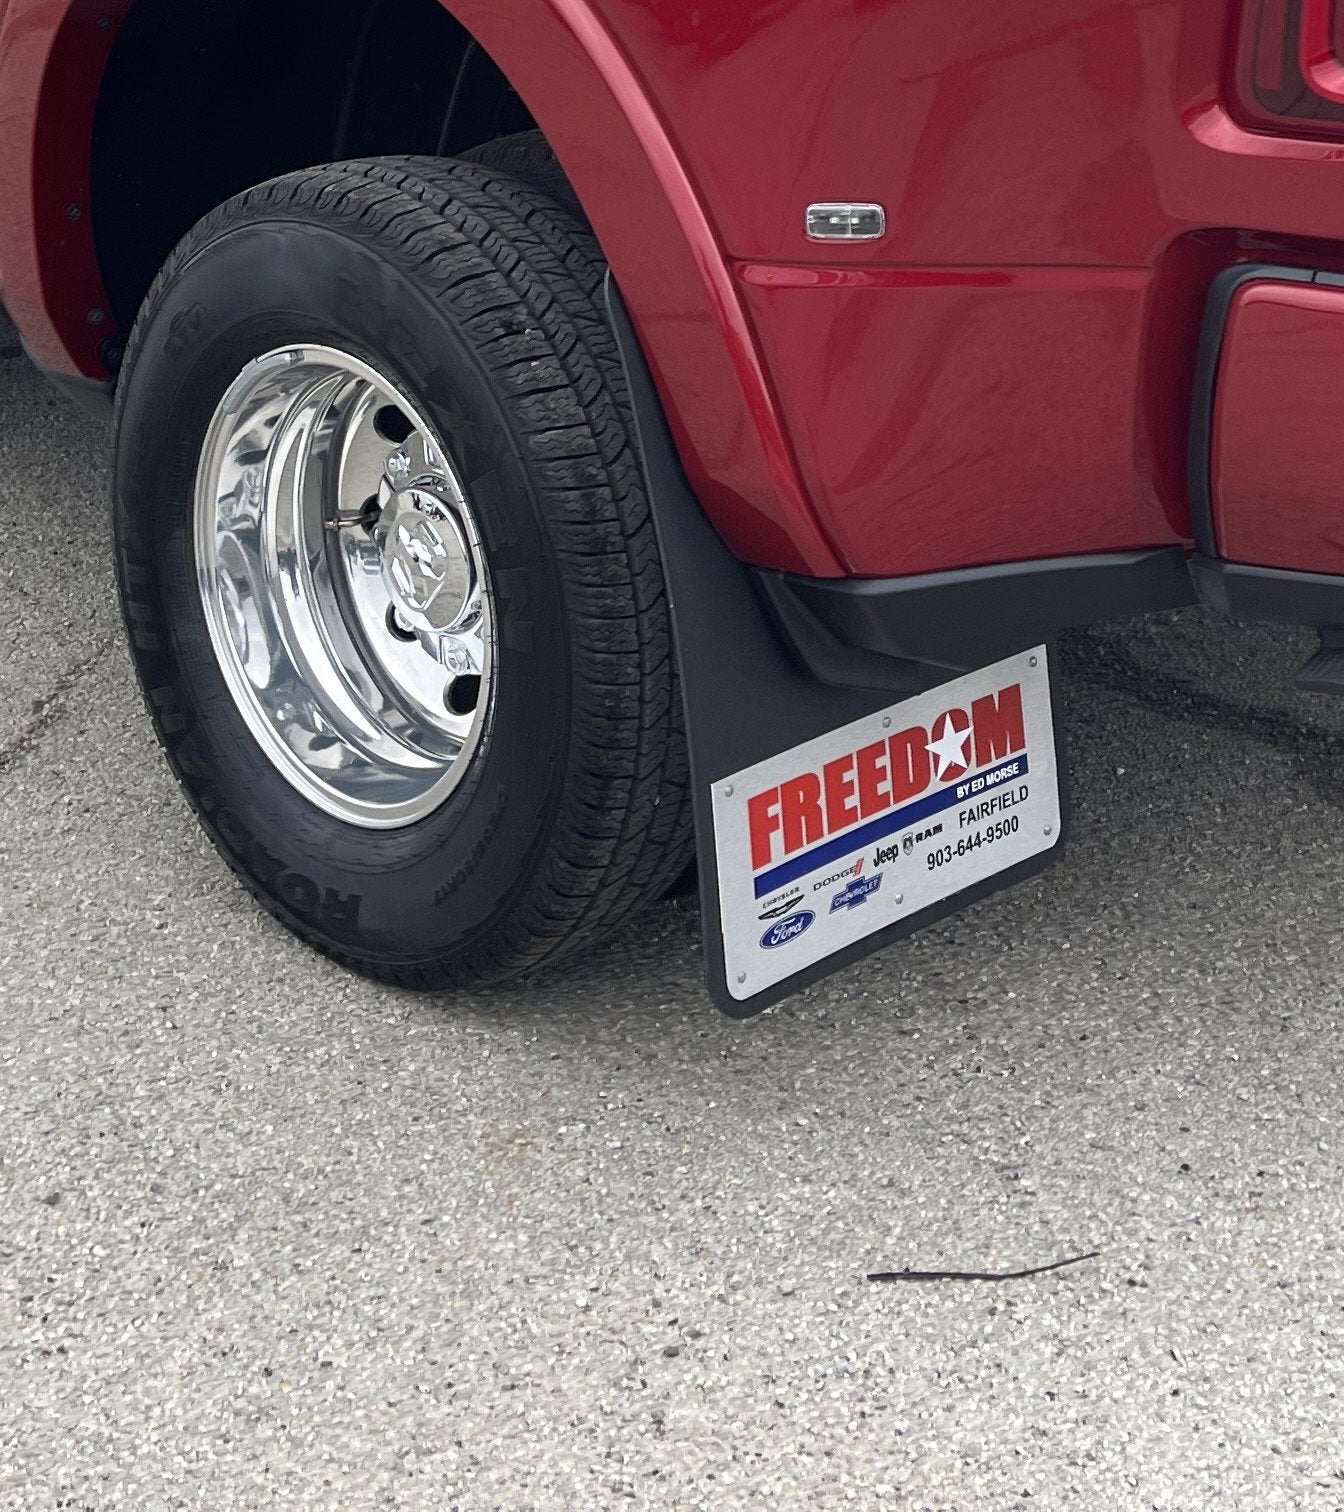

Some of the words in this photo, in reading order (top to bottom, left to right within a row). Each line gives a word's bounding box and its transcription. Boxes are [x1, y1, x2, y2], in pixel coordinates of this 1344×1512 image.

[747, 682, 1027, 872] FREEDOM
[956, 784, 971, 799] BY
[972, 778, 984, 792] ED
[986, 762, 1020, 785] MORSE
[959, 784, 1030, 829] FAIRFIELD
[813, 864, 859, 892] DODGE
[873, 843, 899, 867] Jeep
[915, 823, 943, 843] RAM
[927, 815, 1020, 871] 903-644-9500
[771, 916, 805, 945] Ford
